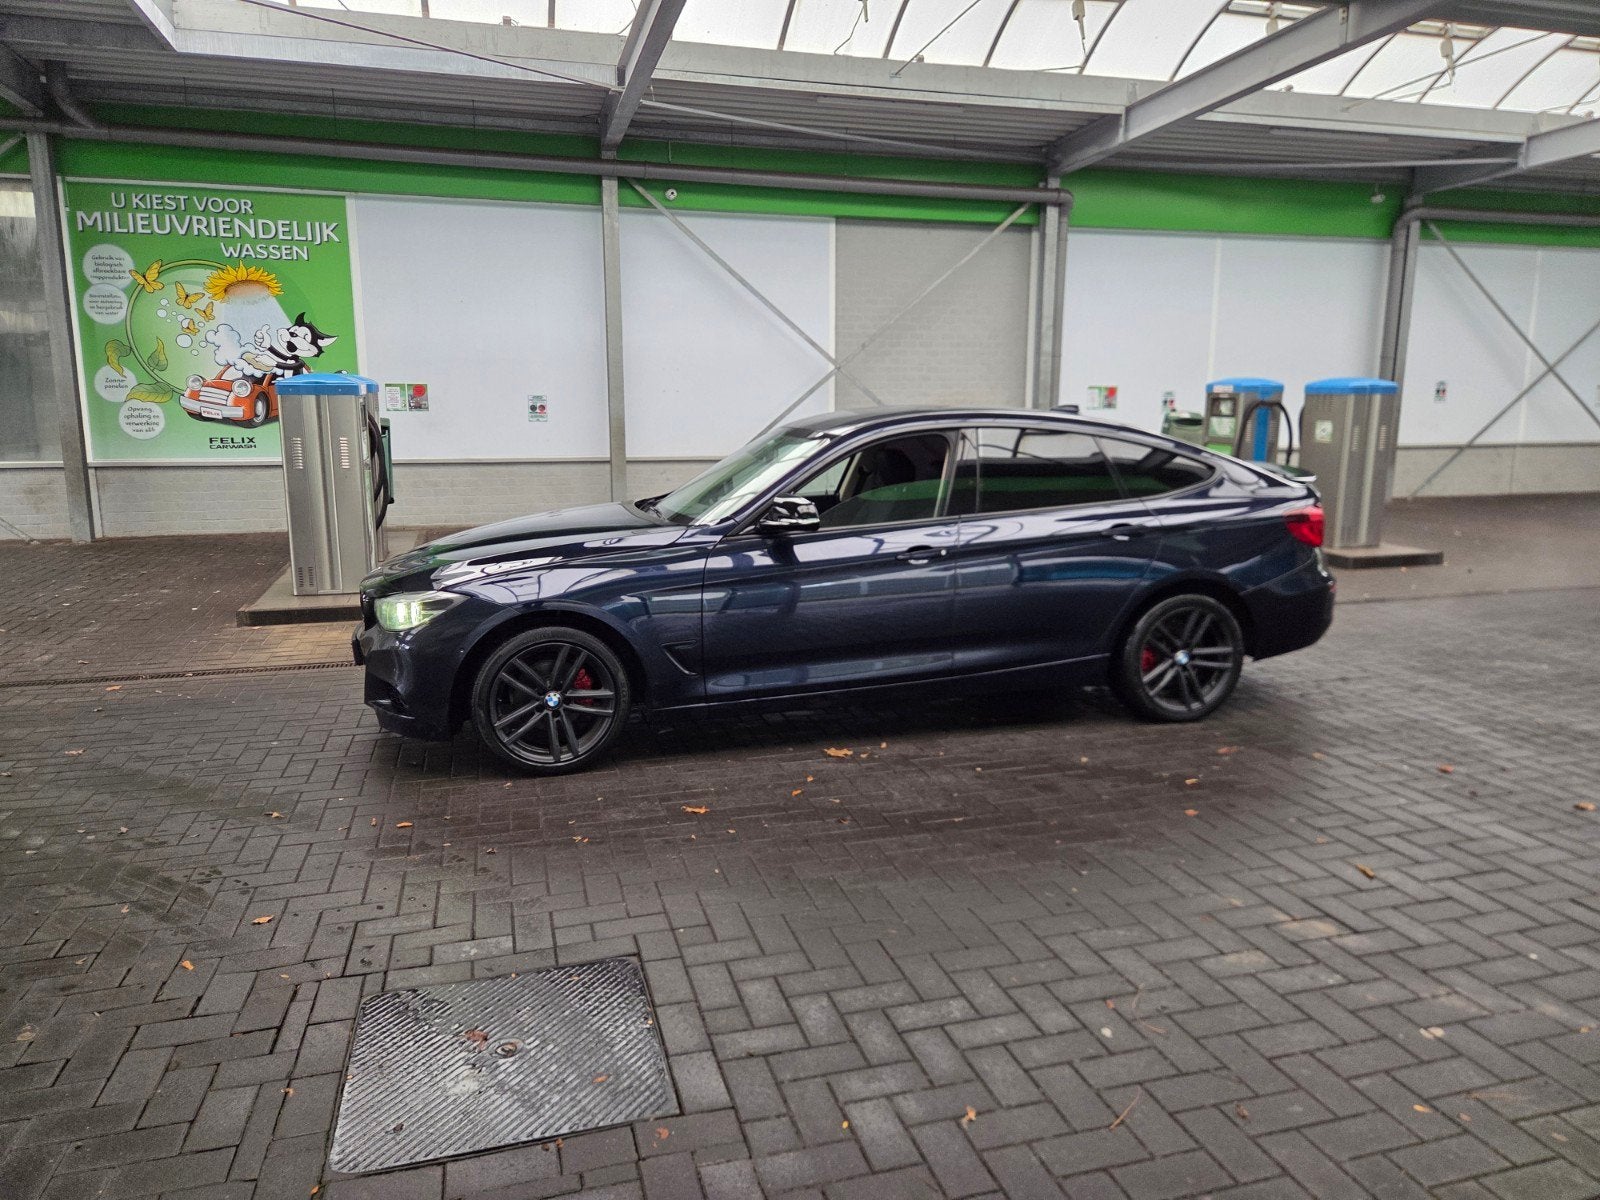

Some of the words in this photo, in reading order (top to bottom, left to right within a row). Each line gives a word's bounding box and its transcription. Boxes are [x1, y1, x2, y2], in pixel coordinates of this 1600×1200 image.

[111, 192, 126, 209] U
[131, 192, 188, 211] KIEST
[193, 196, 254, 215] VOOR
[75, 209, 341, 245] MILIEUVRIENDELIJK
[220, 242, 310, 261] WASSEN
[209, 436, 256, 444] FELIX
